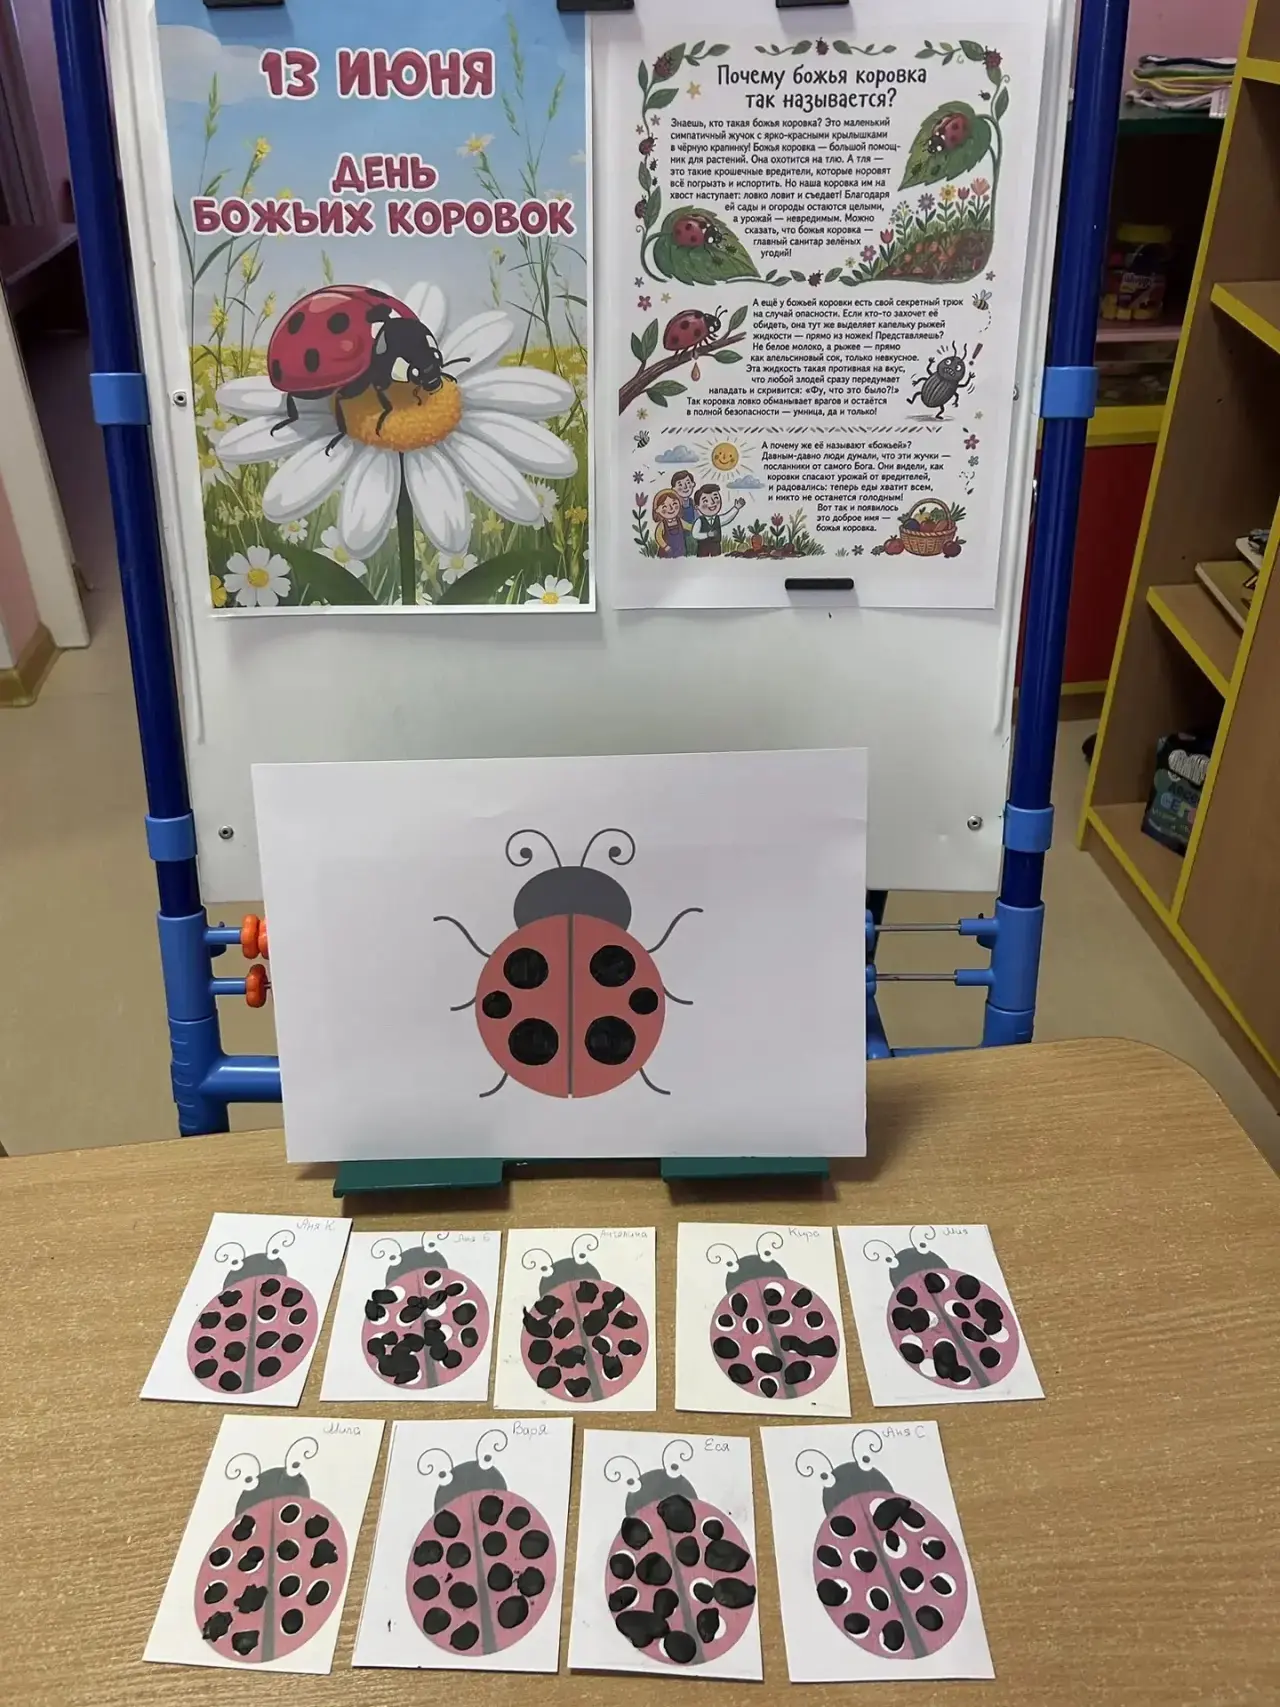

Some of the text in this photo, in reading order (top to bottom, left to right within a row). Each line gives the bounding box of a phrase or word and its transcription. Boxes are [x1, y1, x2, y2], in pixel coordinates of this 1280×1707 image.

[261, 48, 494, 98] 13 ИЮНЯ
[717, 64, 927, 89] Почему божья коровка
[745, 87, 898, 113] так называется?
[670, 116, 891, 129] Знаешь, такая божья коровка? Это маленький
[670, 129, 888, 141] симпатичный жучок ярко-красными крылышками
[677, 141, 902, 154] чёрную крапинку! Божья коровка большой помощ-
[687, 156, 704, 165] для
[705, 153, 749, 165] растений.
[750, 153, 769, 163] Она
[331, 153, 437, 194] ДЕНЬ
[687, 168, 892, 178] такие крошечные вредители, которые норовят
[686, 180, 727, 190] погрызть
[736, 180, 783, 189] испортить.
[823, 180, 859, 189] коровка
[669, 192, 694, 200] хвост
[695, 192, 742, 202] наступает:
[743, 192, 769, 200] ловко
[804, 189, 843, 201] съедает!
[844, 189, 890, 201] Благодаря
[736, 203, 885, 213] сады огороды остаются целыми,
[193, 199, 576, 237] БОЖЬИХ КОРОВОК
[740, 212, 875, 225] урожай невредимым. Можно
[744, 224, 862, 236] сказать, божья коровка
[752, 235, 862, 248] главный санитар зелёных
[760, 247, 792, 259] угодий!
[760, 297, 778, 308] ещё
[785, 297, 817, 307] божьей
[818, 300, 853, 309] коровки
[874, 297, 895, 307] свой
[895, 297, 941, 309] секретный
[942, 299, 964, 308] трюк
[764, 308, 794, 320] случай
[842, 308, 863, 318] Если
[864, 310, 893, 318] кто-то
[893, 310, 927, 318] захочет
[752, 319, 946, 330] обидеть, выделяет капельку рыжей
[752, 330, 945, 341] жидкости прямо ножек! Представляешь?
[764, 341, 902, 353] белое молоко, рыжее прямо
[766, 352, 825, 362] апельсиновый
[825, 355, 843, 363] сок,
[874, 355, 920, 364] невкусное.
[762, 365, 906, 374] жидкость такая противная вкус,
[767, 374, 901, 385] любой злодей сразу передумает
[708, 387, 748, 395] нападать
[756, 387, 803, 396] скривится:
[805, 384, 827, 396] «Фу,
[862, 384, 900, 394] было?!»
[702, 398, 736, 407] коровка
[762, 396, 813, 405] обманывает
[814, 398, 842, 407] врагов
[850, 396, 888, 405] остаётся
[693, 406, 878, 418] полной безопасности умница, только!
[769, 442, 800, 451] почему
[867, 440, 913, 449] «божьей»?
[761, 451, 940, 462] Давным-давно люди думали, жучки
[852, 461, 877, 470] Бога.
[876, 461, 895, 470] Они
[895, 463, 928, 471] видели,
[767, 474, 801, 483] коровки
[837, 471, 868, 482] урожай
[880, 471, 931, 482] вредителей,
[775, 484, 828, 493] радовались:
[829, 484, 860, 493] теперь
[860, 484, 879, 492] еды
[910, 484, 934, 492] всем,
[858, 492, 904, 502] голодным!
[831, 513, 863, 524] доброе
[815, 523, 878, 534] божья коровка.
[512, 1420, 549, 1441] Варя
[704, 1437, 730, 1452] Еся
